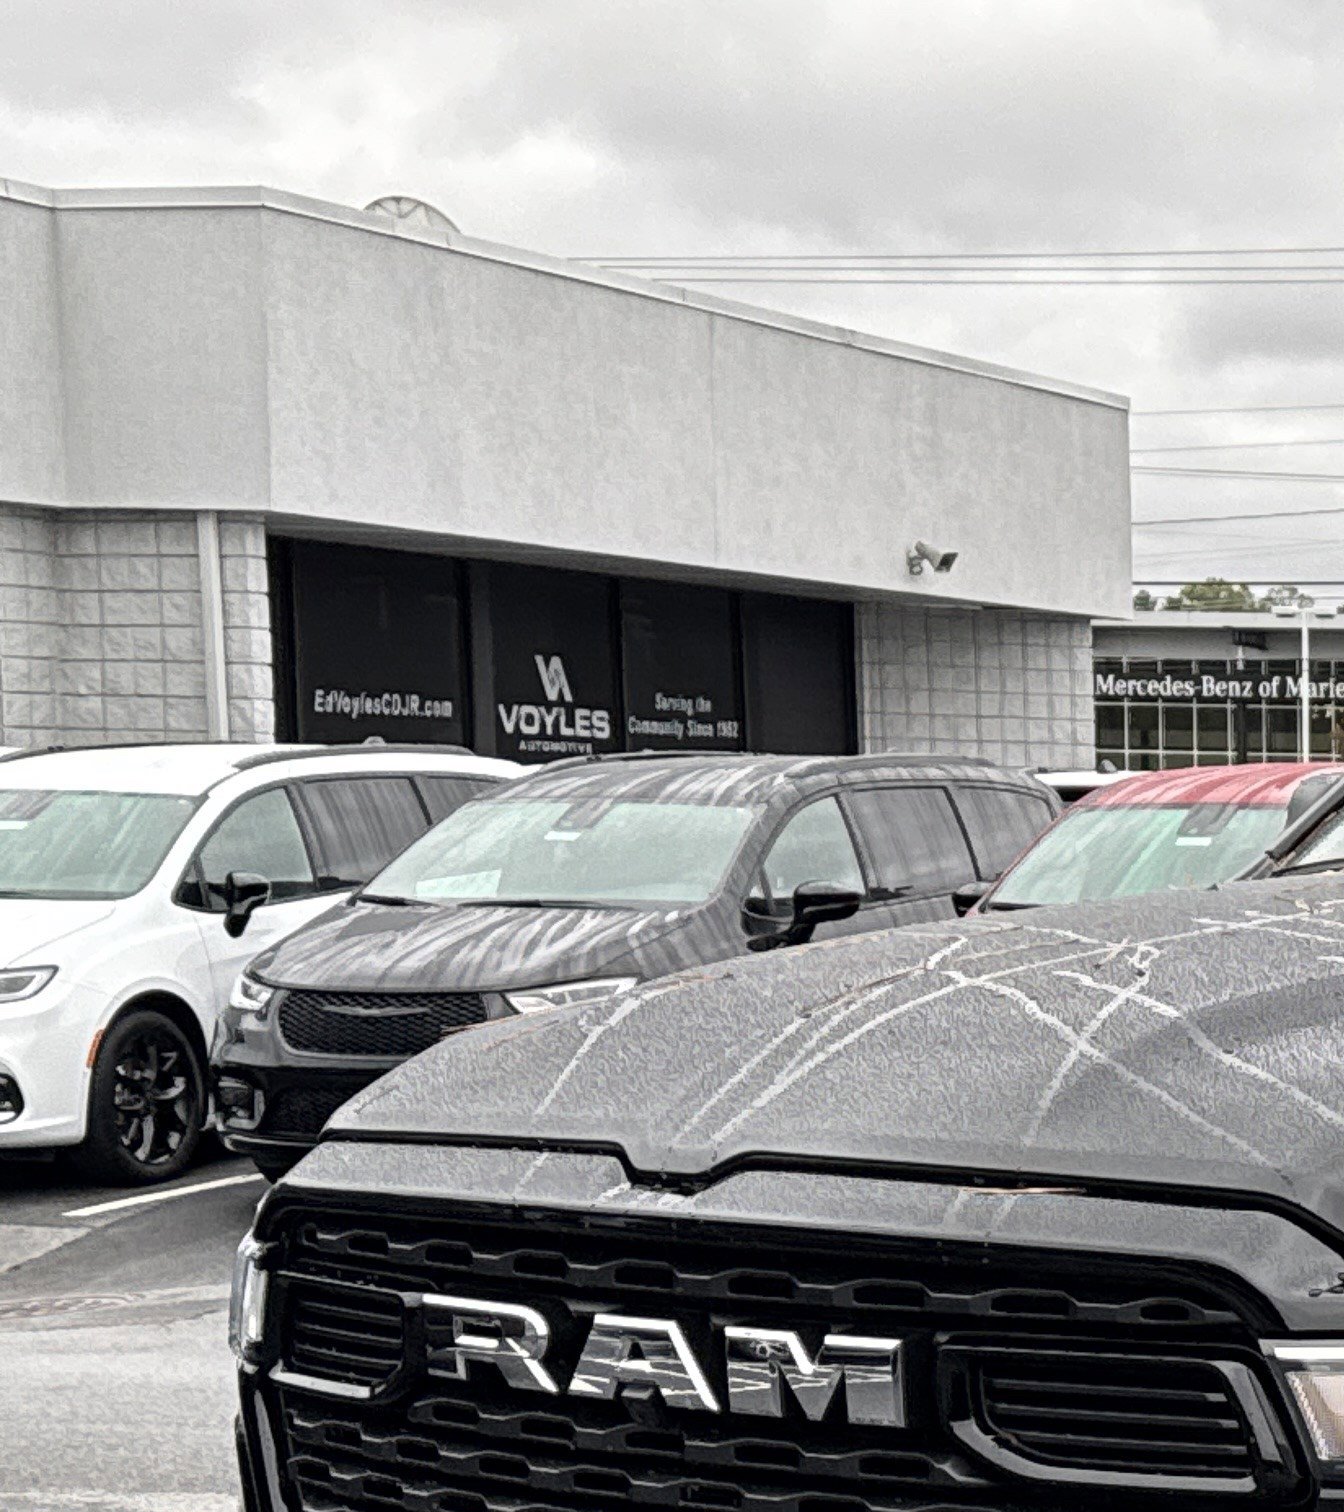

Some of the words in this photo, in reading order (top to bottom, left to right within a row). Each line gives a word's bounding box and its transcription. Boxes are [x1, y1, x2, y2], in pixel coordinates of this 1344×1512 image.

[1094, 674, 1253, 699] Mercedes-Benz
[1258, 675, 1281, 698] of
[314, 689, 453, 720] EdVoylesCDJR.com
[498, 703, 610, 739] VOYLES
[518, 740, 593, 755] AUTOMOTIVE
[421, 1293, 905, 1428] RAM
